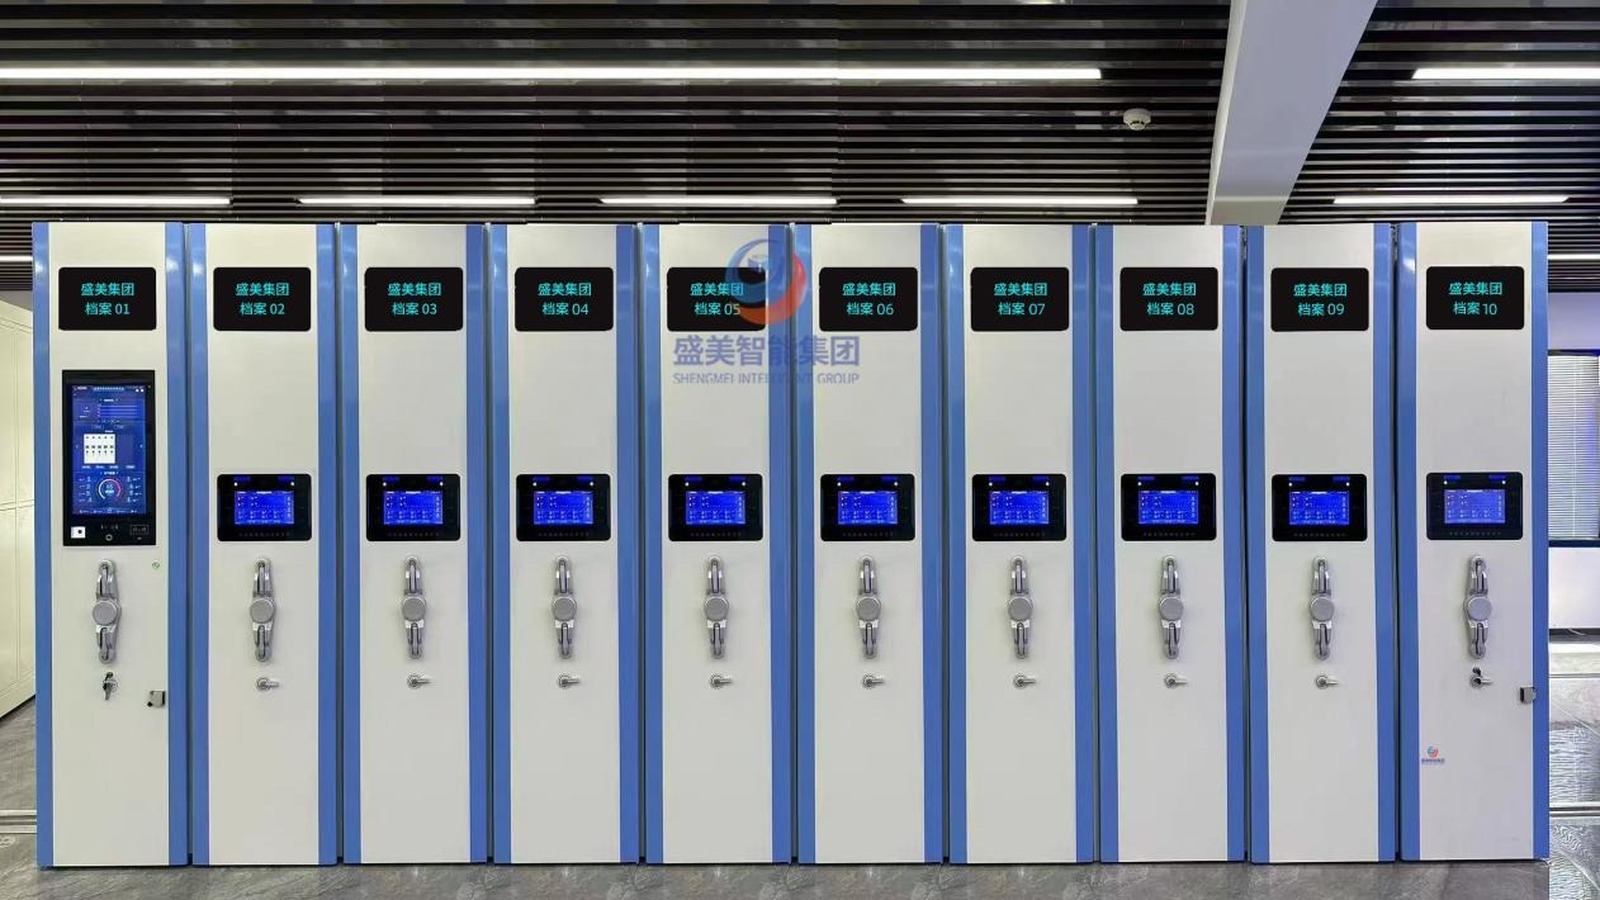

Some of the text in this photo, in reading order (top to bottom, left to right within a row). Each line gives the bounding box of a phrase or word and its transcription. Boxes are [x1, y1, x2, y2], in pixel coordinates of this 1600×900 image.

[80, 282, 135, 297] 盛美集团
[235, 282, 290, 297] 盛美集团
[387, 282, 442, 297] 盛美集团
[538, 282, 592, 297] 盛美集团
[690, 282, 744, 297] 盛美集团
[842, 282, 896, 297] 盛美集团
[994, 282, 1048, 297] 盛美集团
[1143, 282, 1197, 297] 盛美集团
[1294, 283, 1347, 297] 盛美集团
[1449, 281, 1503, 296] 盛美集团
[85, 302, 130, 316] 档案 01
[239, 302, 285, 316] 档案 02
[392, 302, 437, 316] 档案 03
[542, 302, 589, 316] 档案 04
[694, 302, 741, 316] 档案 05
[847, 302, 893, 316] 档案 06
[998, 302, 1046, 316] 档案 07
[1147, 302, 1195, 316] 档案 08
[1297, 302, 1345, 316] 档案 09
[1453, 301, 1498, 316] 档案 10
